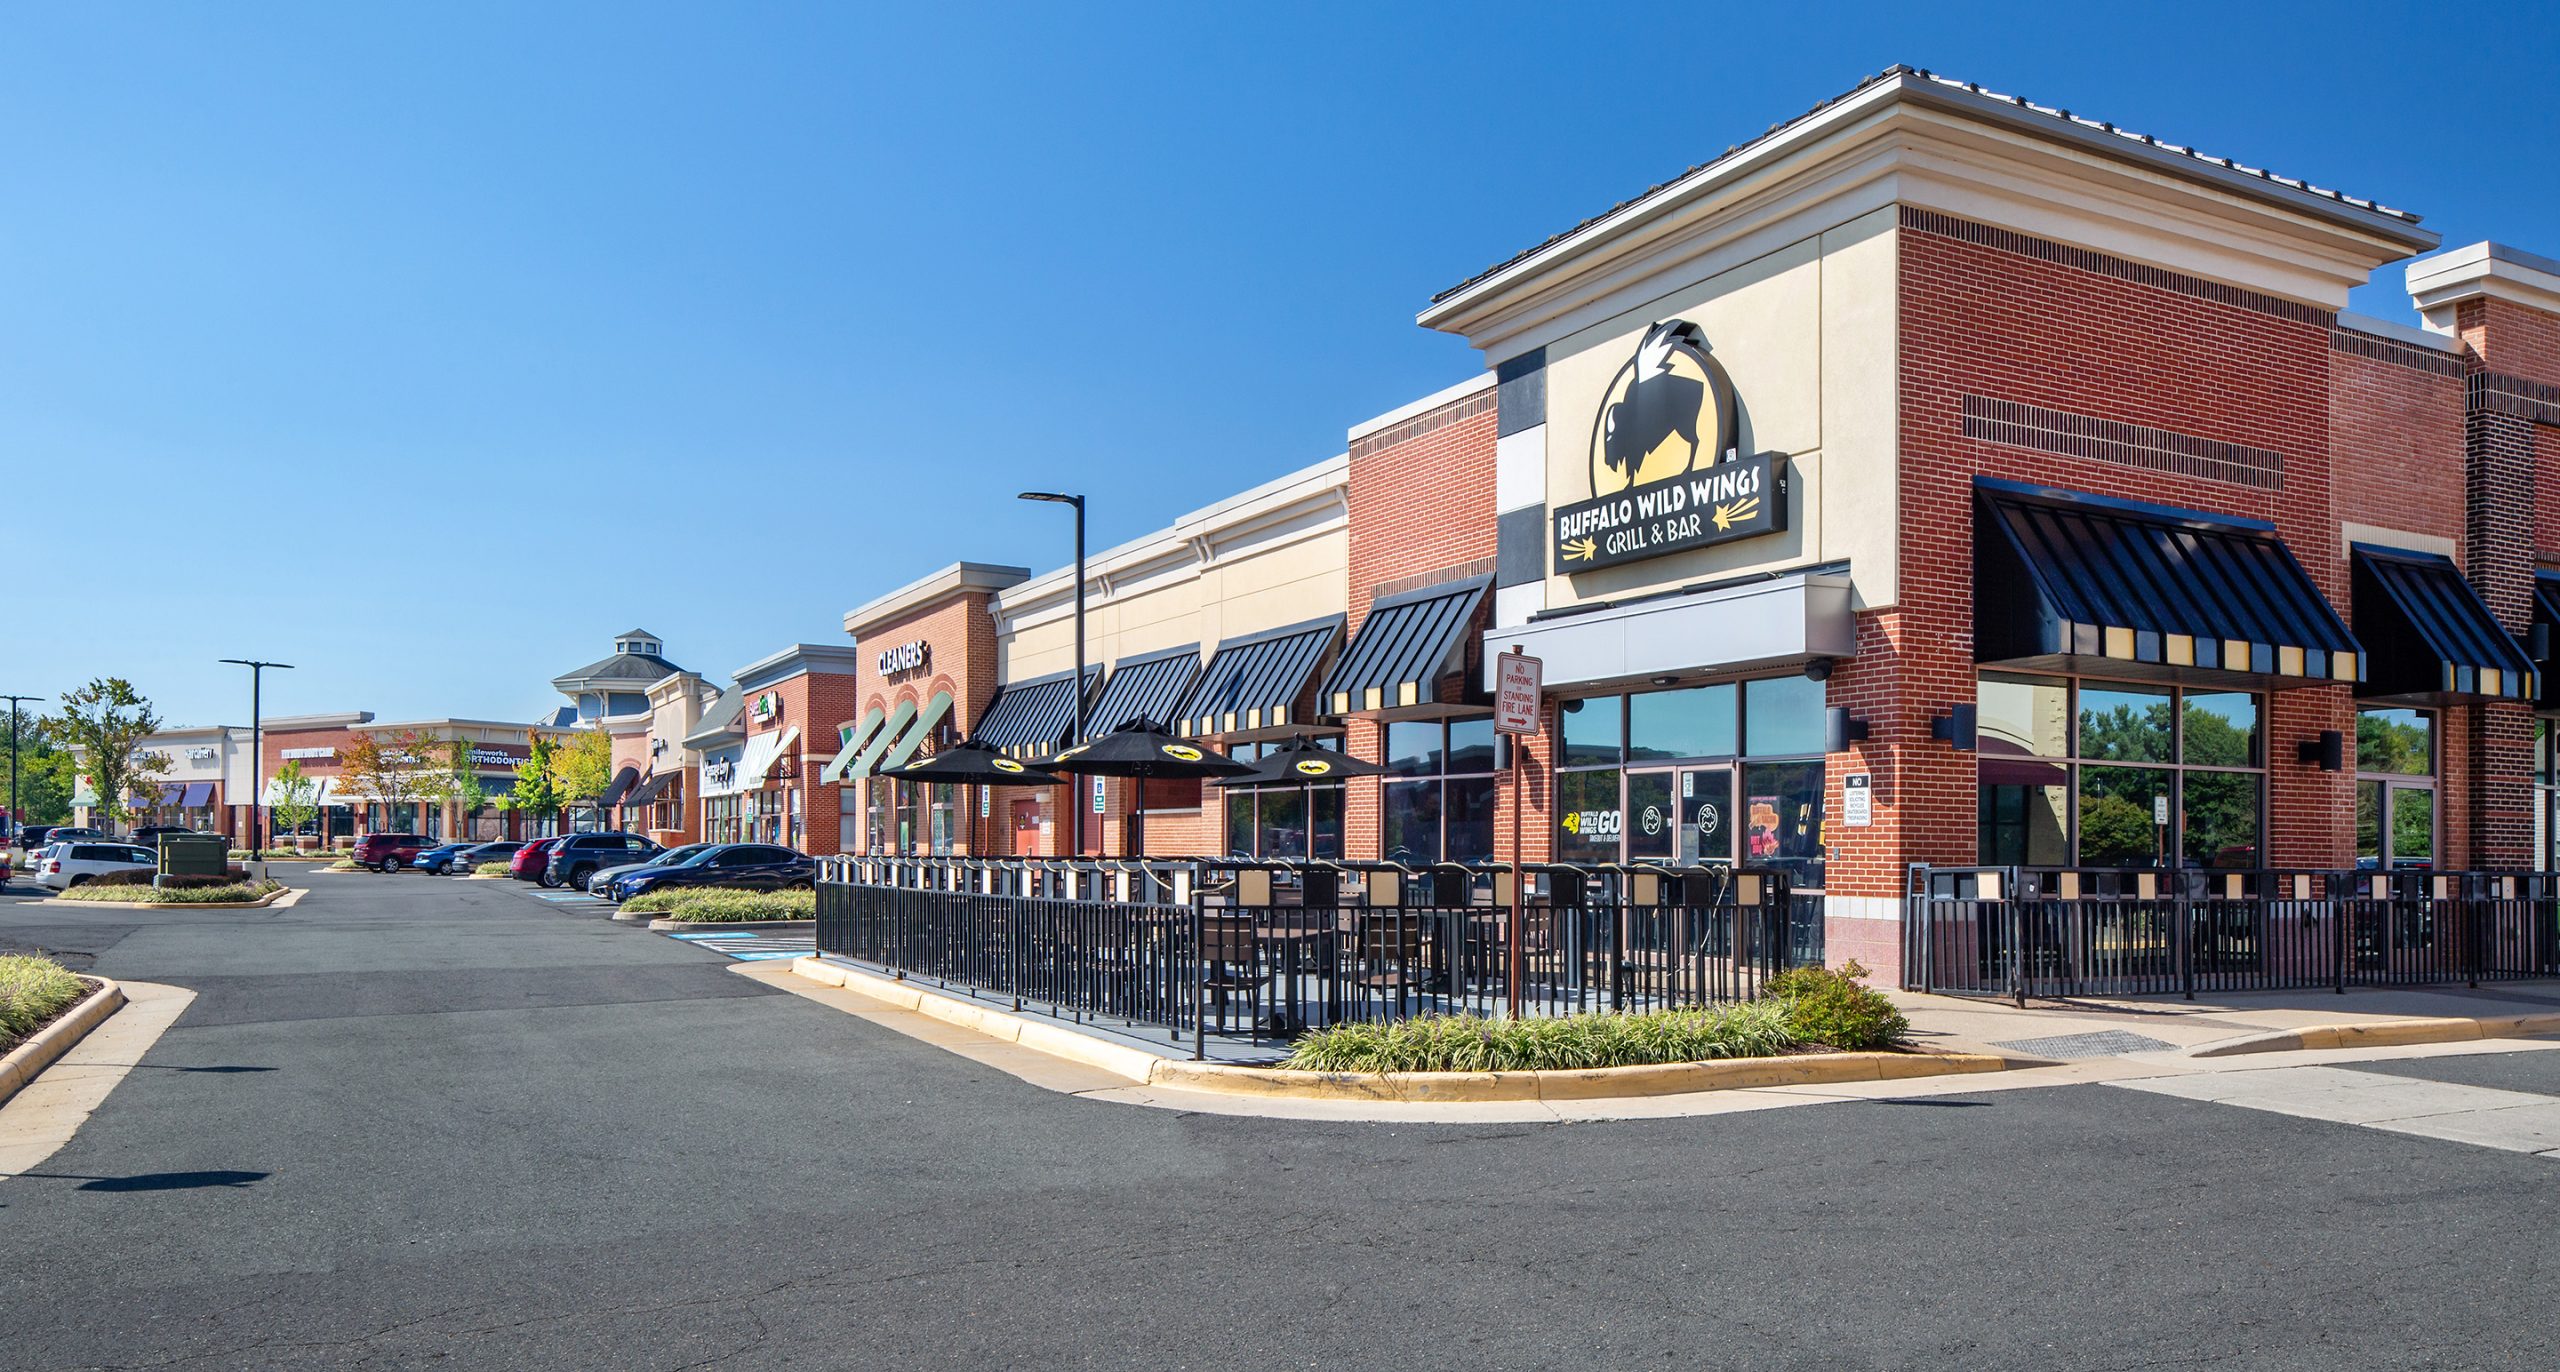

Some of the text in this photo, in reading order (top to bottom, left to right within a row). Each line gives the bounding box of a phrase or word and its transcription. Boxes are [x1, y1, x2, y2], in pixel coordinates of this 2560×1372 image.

[1560, 465, 1760, 541] BUFFALO WILD WINGS
[1606, 513, 1702, 555] GRILL & BAR
[878, 639, 923, 677] CLEANERS
[1515, 664, 1525, 675] NO
[1506, 673, 1533, 687] PARKING
[1503, 690, 1534, 704] STANDING
[1502, 701, 1533, 716] FIRE LANE
[1852, 777, 1863, 787] NO
[1581, 817, 1598, 827] WILD
[1598, 810, 1620, 834] GO
[1580, 826, 1597, 834] WINGS
